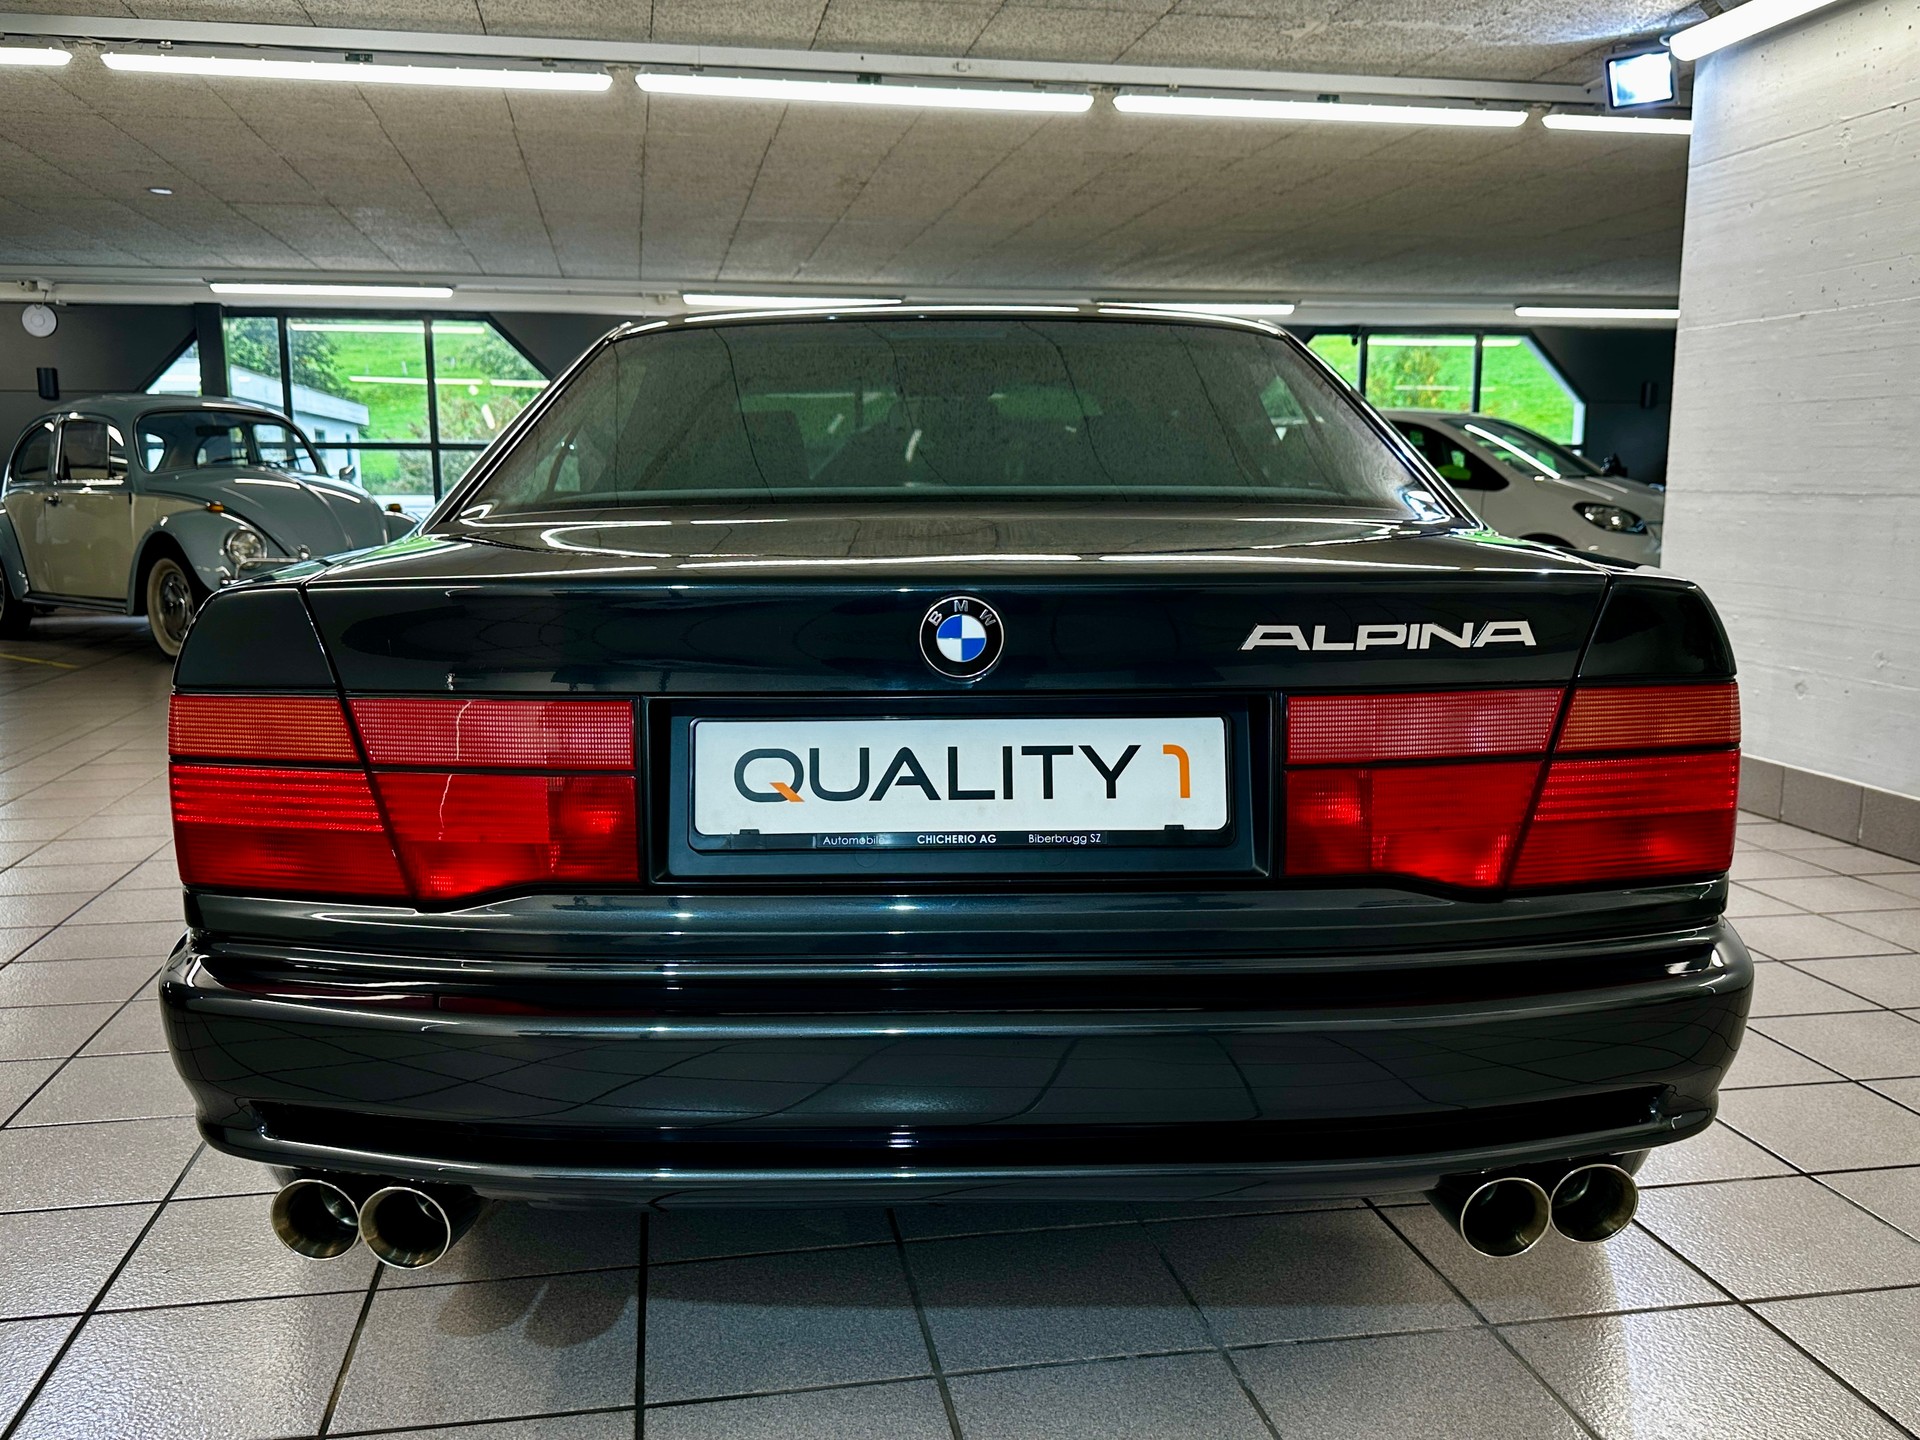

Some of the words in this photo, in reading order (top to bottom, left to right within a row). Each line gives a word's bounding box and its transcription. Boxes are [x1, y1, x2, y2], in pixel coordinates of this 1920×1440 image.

[928, 600, 996, 626] BMW
[1240, 620, 1537, 651] ALPINA
[734, 744, 1142, 802] QUALITY
[1162, 744, 1191, 799] 1
[916, 834, 976, 845] CHICHERIO
[979, 834, 997, 844] AG
[1028, 833, 1087, 845] Biberbrugg
[1090, 833, 1101, 843] SZ
